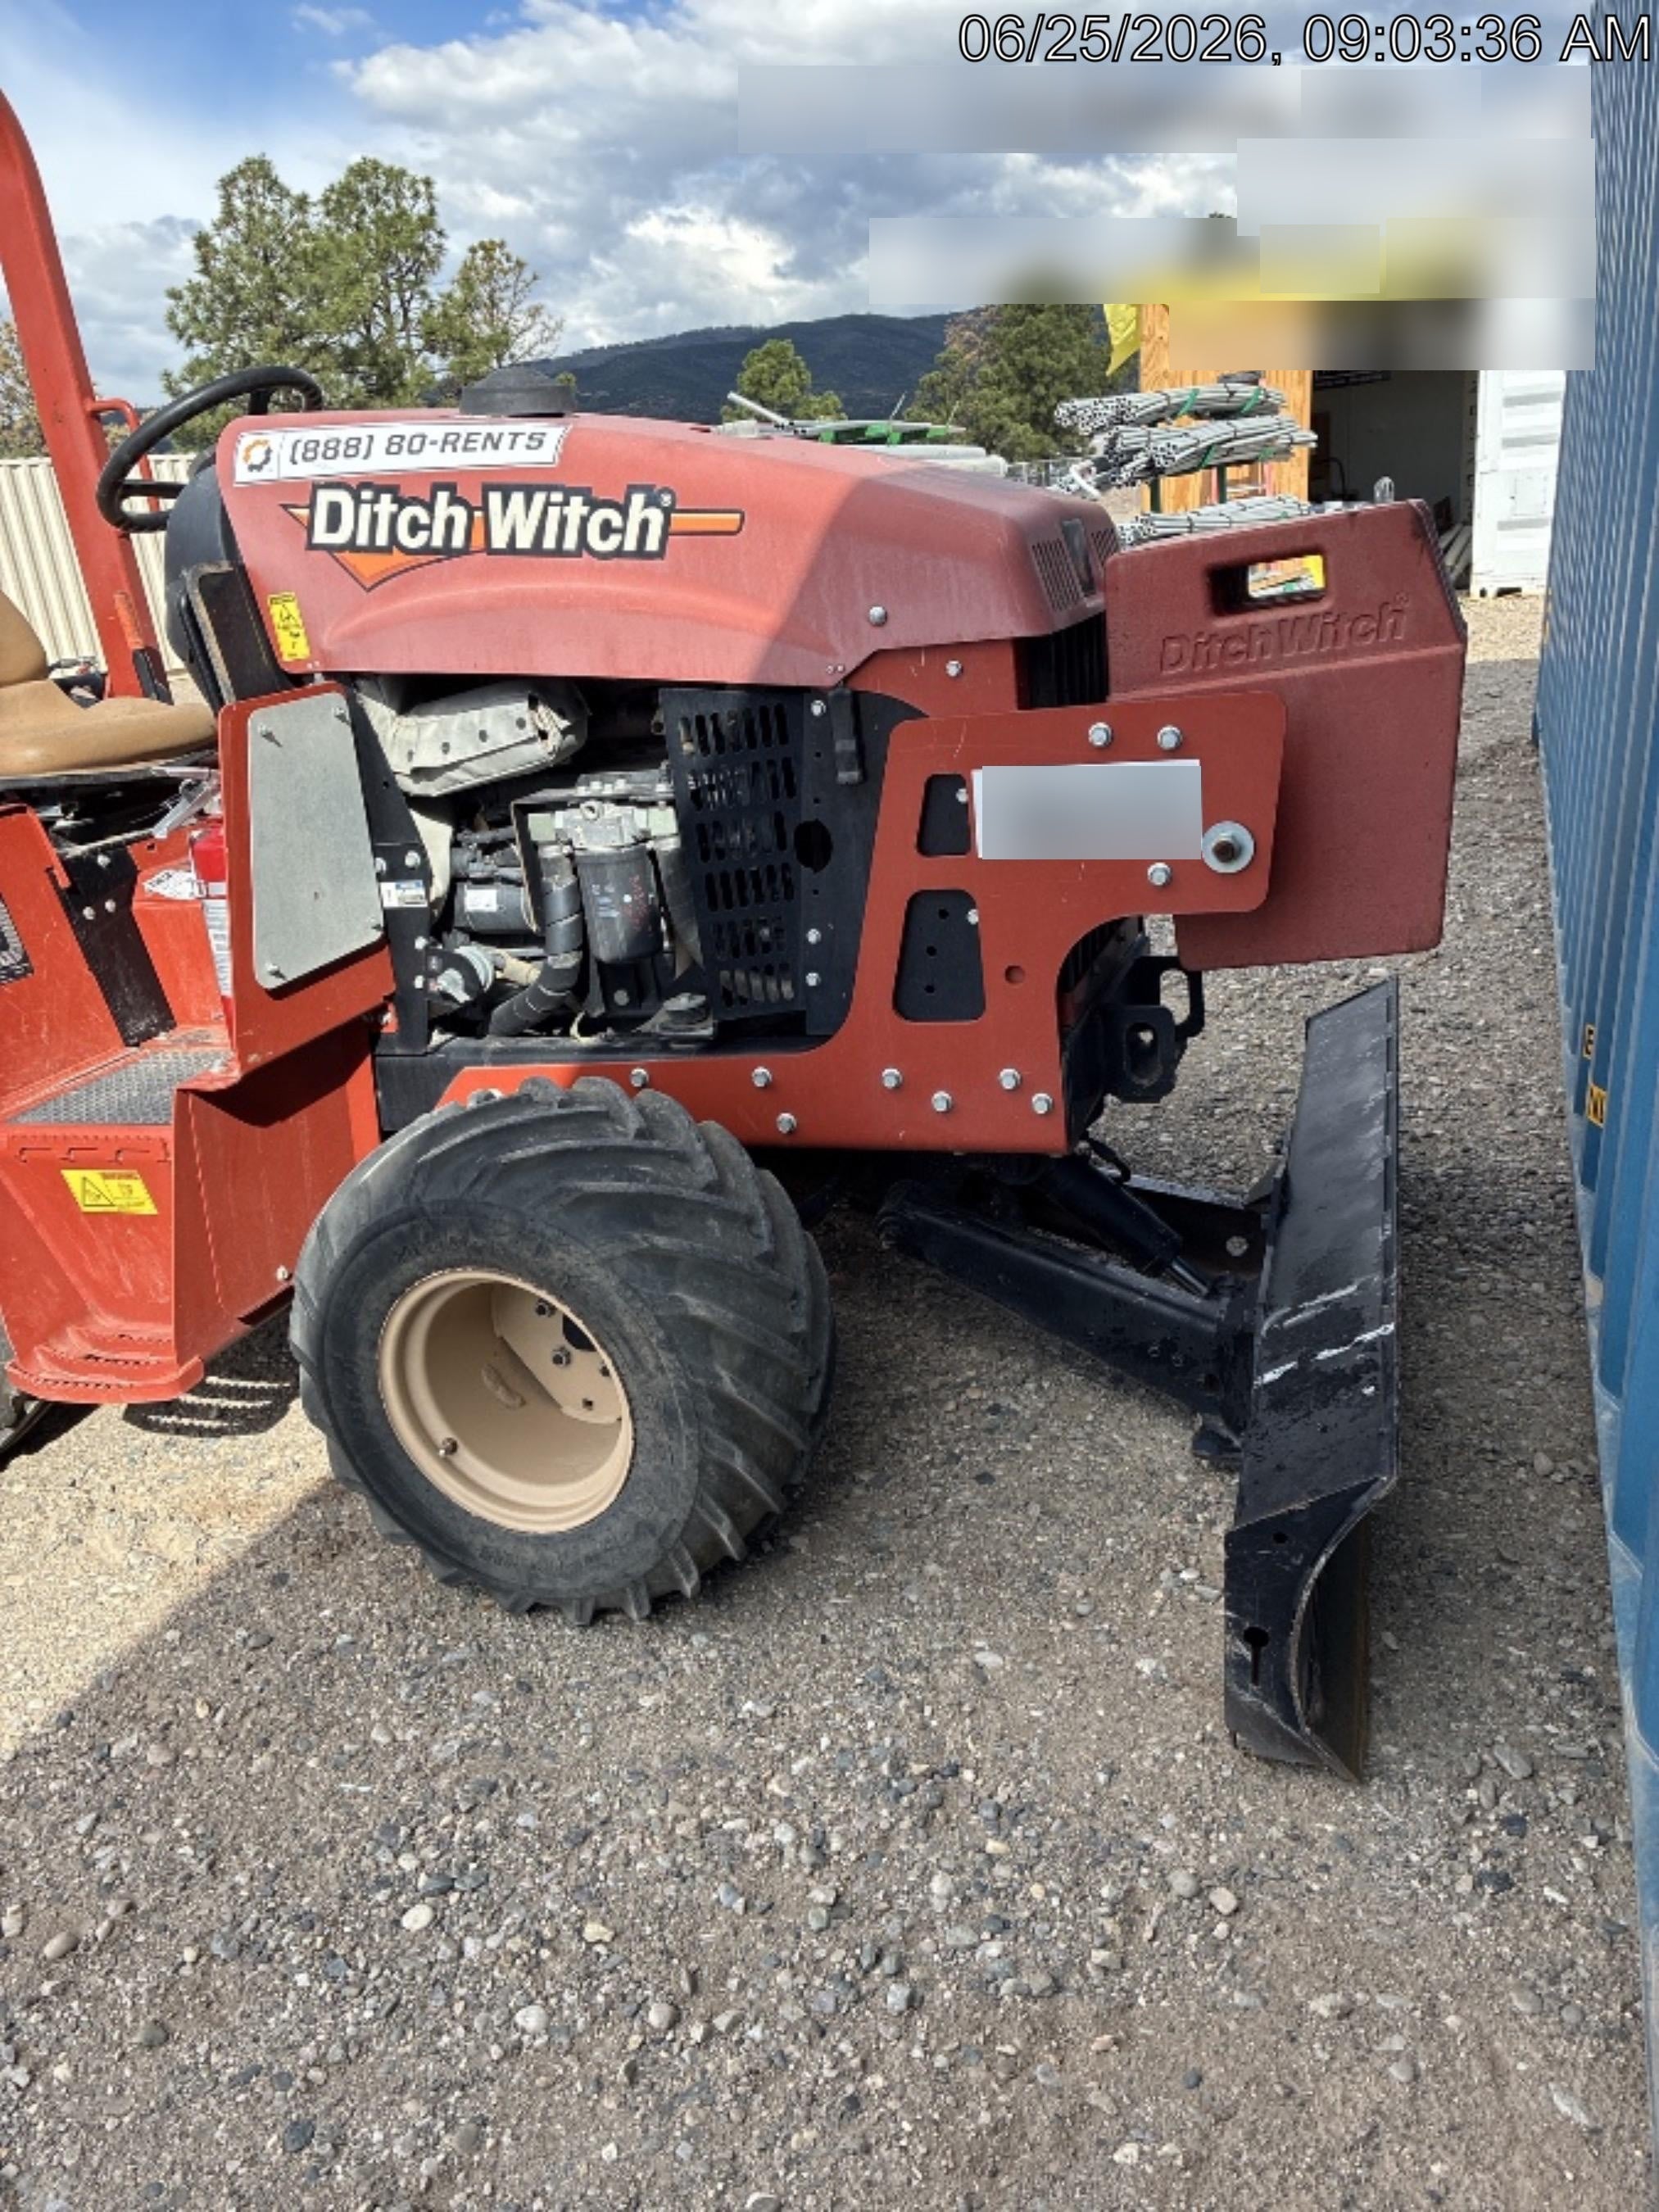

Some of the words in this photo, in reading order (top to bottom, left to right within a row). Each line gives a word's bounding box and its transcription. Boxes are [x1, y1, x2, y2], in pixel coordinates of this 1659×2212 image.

[289, 434, 374, 465] (888)
[385, 431, 547, 456] 80-RENTS
[310, 486, 469, 551] Ditch
[1158, 623, 1272, 676] Ditch
